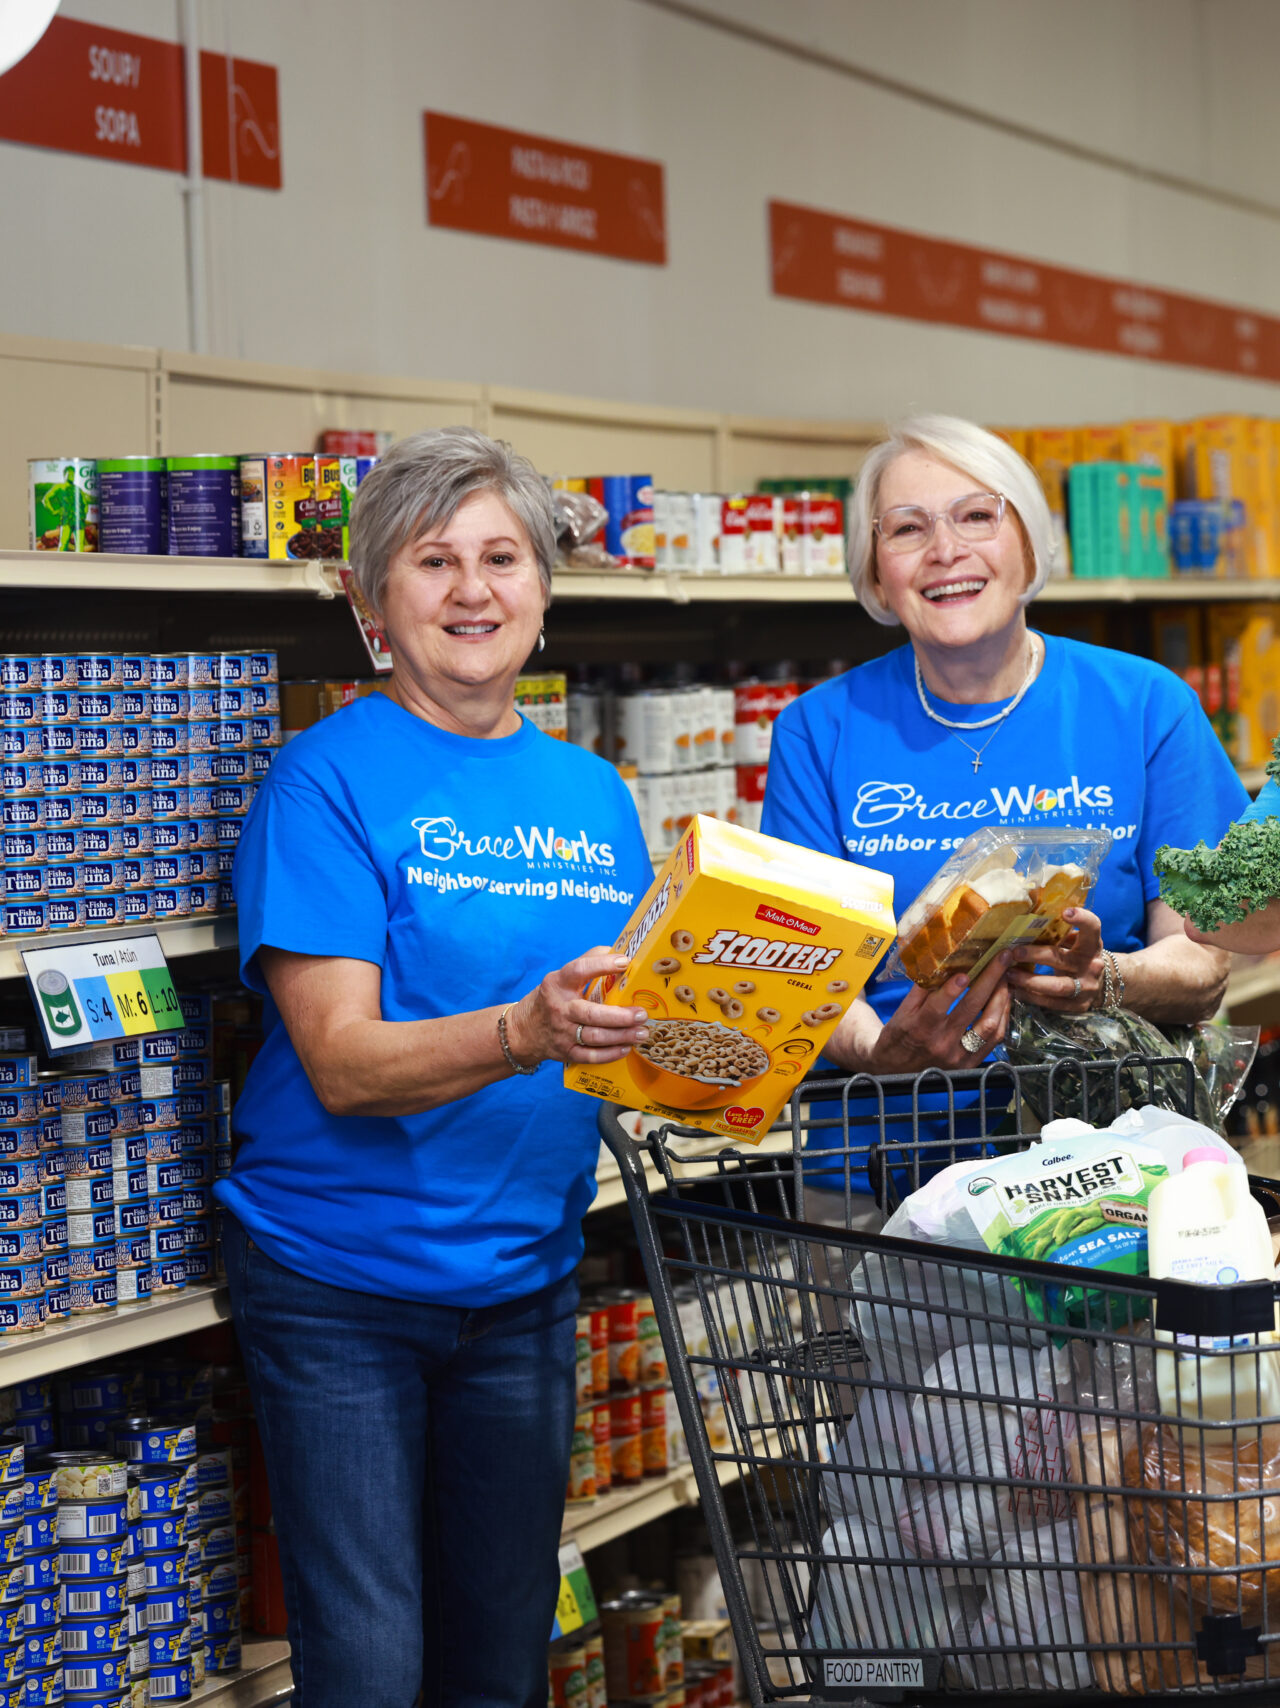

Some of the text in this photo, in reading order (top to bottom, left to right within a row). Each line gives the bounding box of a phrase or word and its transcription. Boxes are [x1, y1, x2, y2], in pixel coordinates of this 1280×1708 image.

[89, 45, 141, 88] SOUP/
[95, 105, 141, 147] SOPA
[852, 775, 1113, 828] GraceWorks
[1000, 808, 1115, 825] MINISTRIES INC
[411, 816, 615, 867] GraceWorks
[526, 861, 617, 877] MINISTRIES INC
[6, 876, 40, 890] Tuna
[407, 866, 634, 906] Neighbor serving Neighbor
[7, 913, 42, 926] Tuna
[765, 910, 786, 924] Malt
[793, 918, 818, 935] Meal
[93, 953, 116, 967] Tuna
[693, 929, 843, 975] SCOOTERS
[787, 978, 813, 991] CEREAL
[102, 997, 113, 1021] 4
[136, 991, 148, 1015] 6
[161, 987, 178, 1012] 10
[146, 1043, 176, 1056] Tuna
[1042, 1154, 1073, 1167] Calbee
[1004, 1156, 1124, 1200] HARVEST
[1028, 1177, 1118, 1204] SNAPS
[1105, 1207, 1148, 1222] ORGAN
[1078, 1238, 1106, 1254] SEA
[1107, 1232, 1140, 1243] SALT
[826, 1662, 920, 1682] FOOD PANTRY
